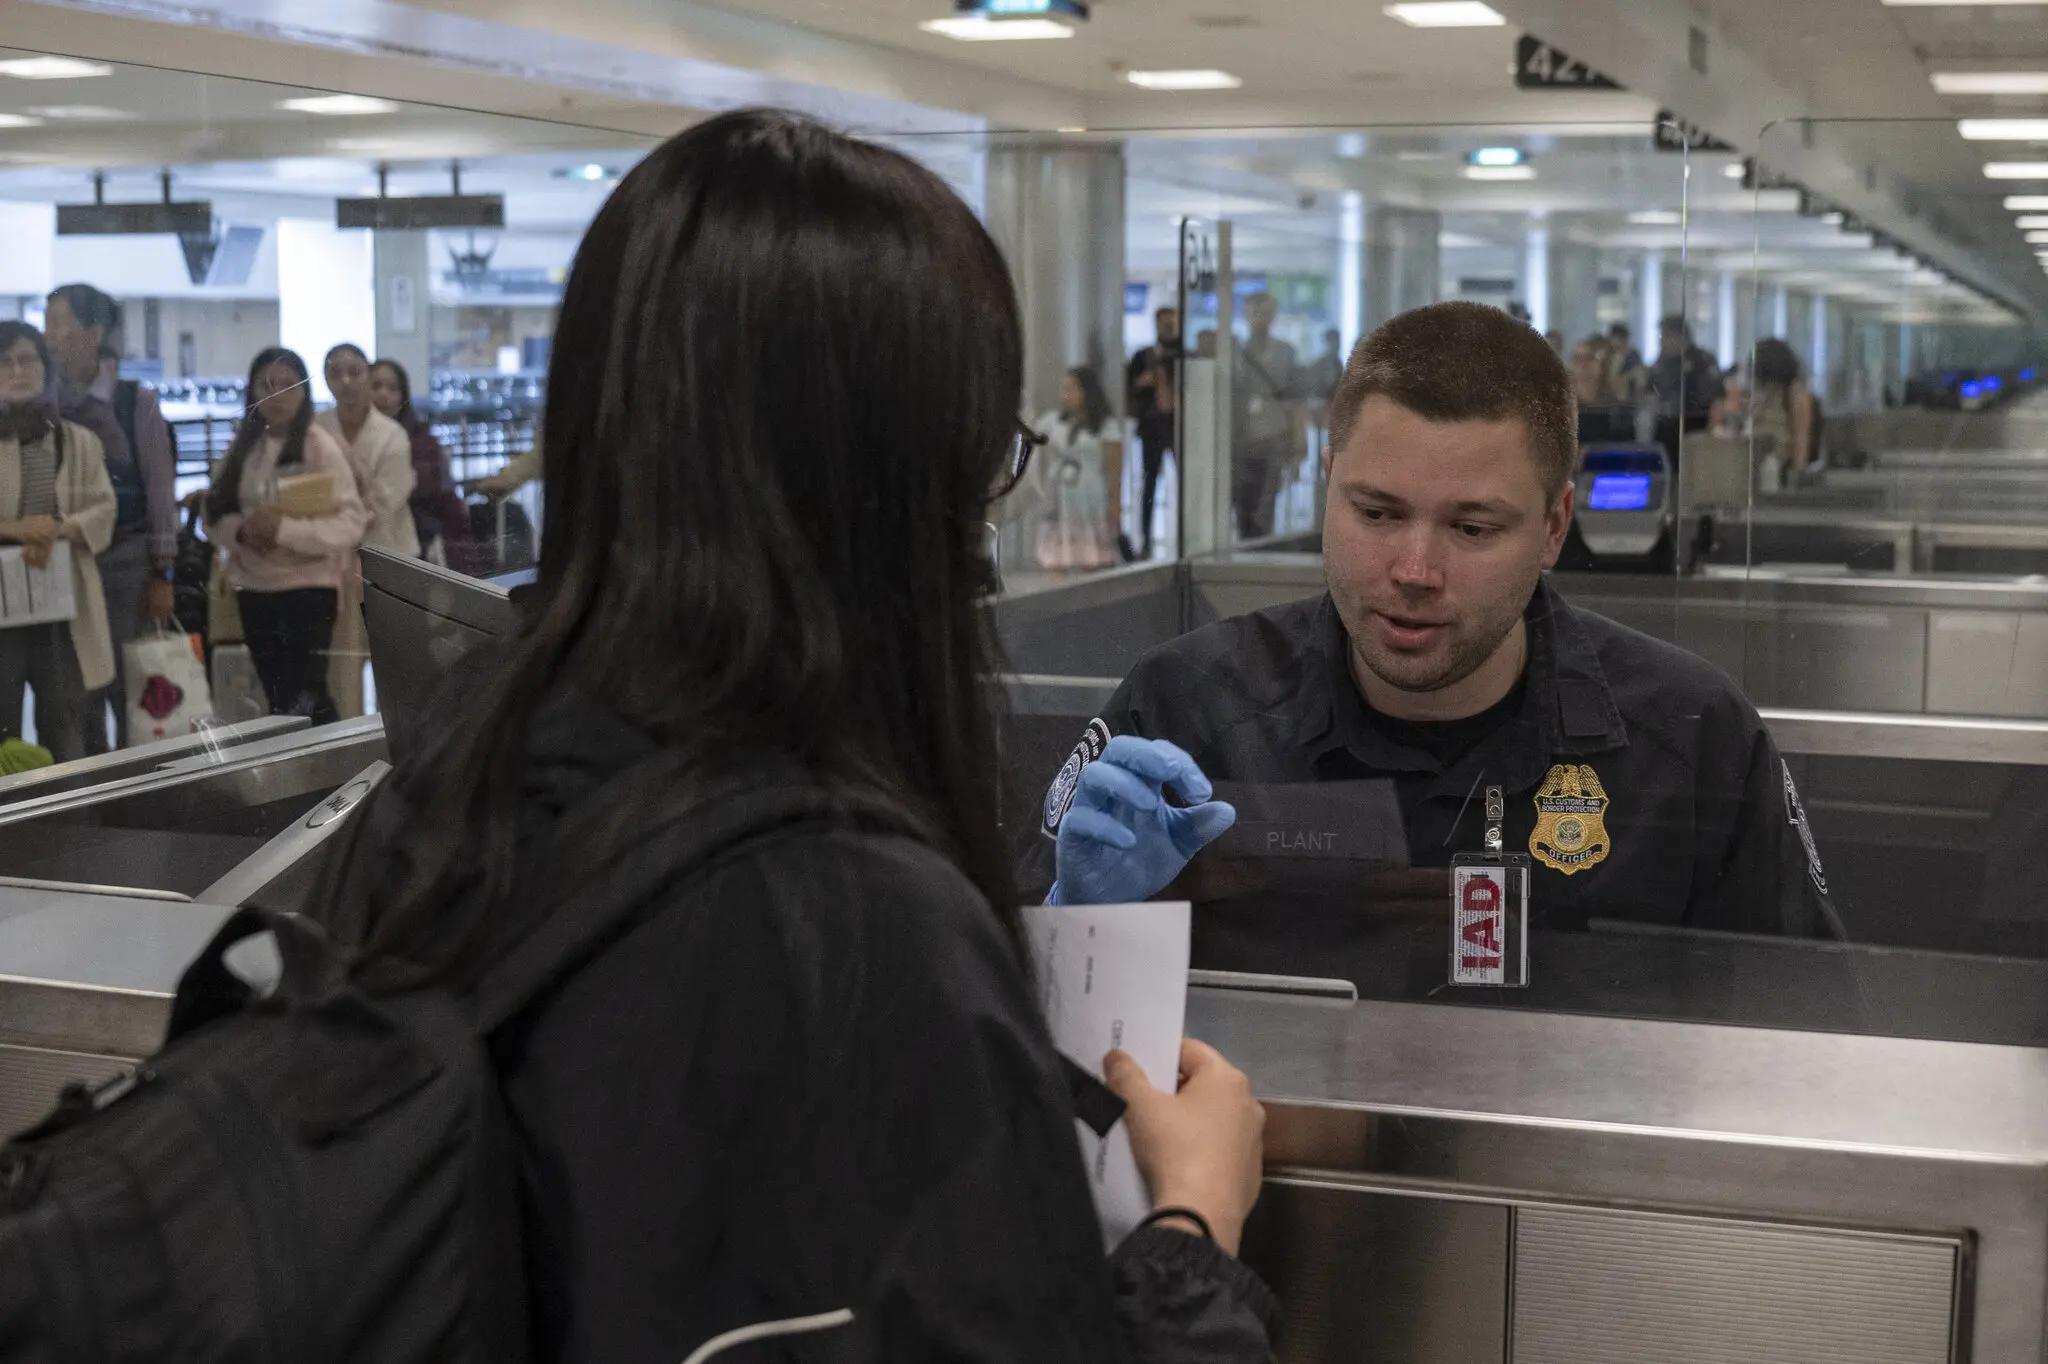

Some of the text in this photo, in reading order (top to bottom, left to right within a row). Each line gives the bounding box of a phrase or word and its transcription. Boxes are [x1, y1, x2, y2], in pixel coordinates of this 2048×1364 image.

[1555, 798, 1585, 806] CUSTOMS
[1566, 805, 1600, 813] PROTECTION
[1266, 831, 1338, 851] PLANT
[1549, 849, 1592, 864] OFFICER
[1461, 876, 1500, 969] IAD
